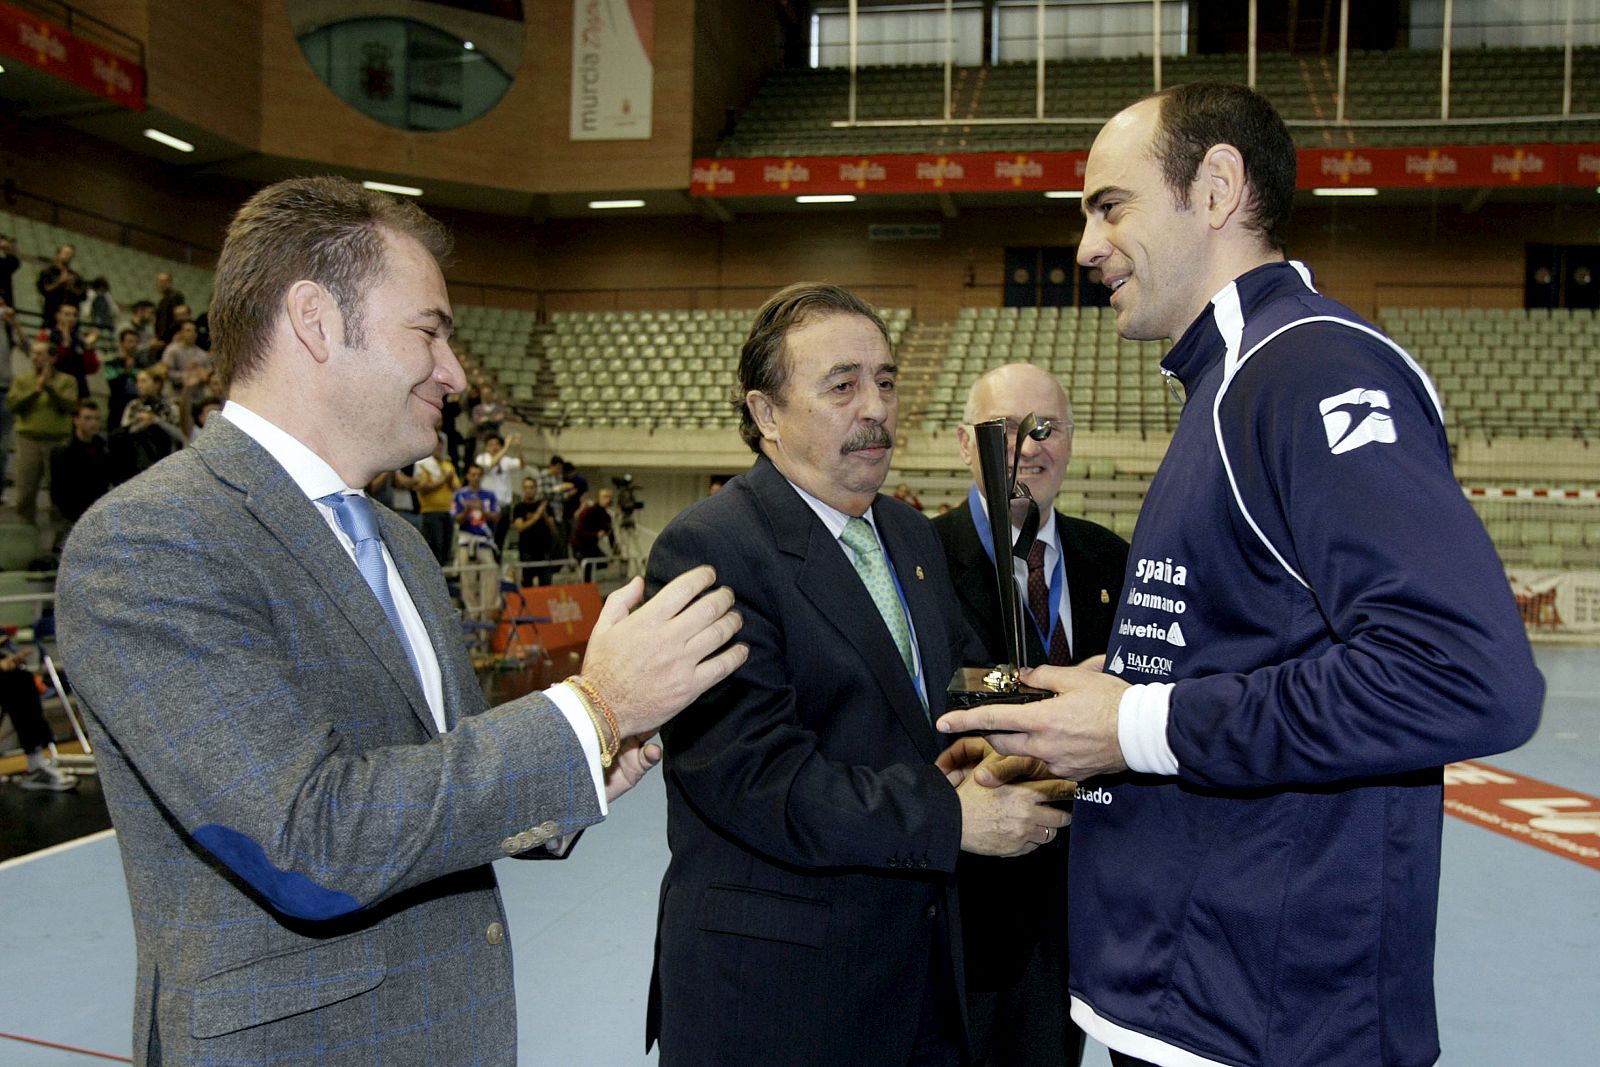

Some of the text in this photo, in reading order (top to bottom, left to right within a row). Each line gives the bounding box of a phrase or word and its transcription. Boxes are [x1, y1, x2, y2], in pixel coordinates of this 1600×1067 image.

[579, 52, 600, 131] murcia
[1127, 652, 1173, 672] HALCON
[1073, 787, 1113, 805] stado
